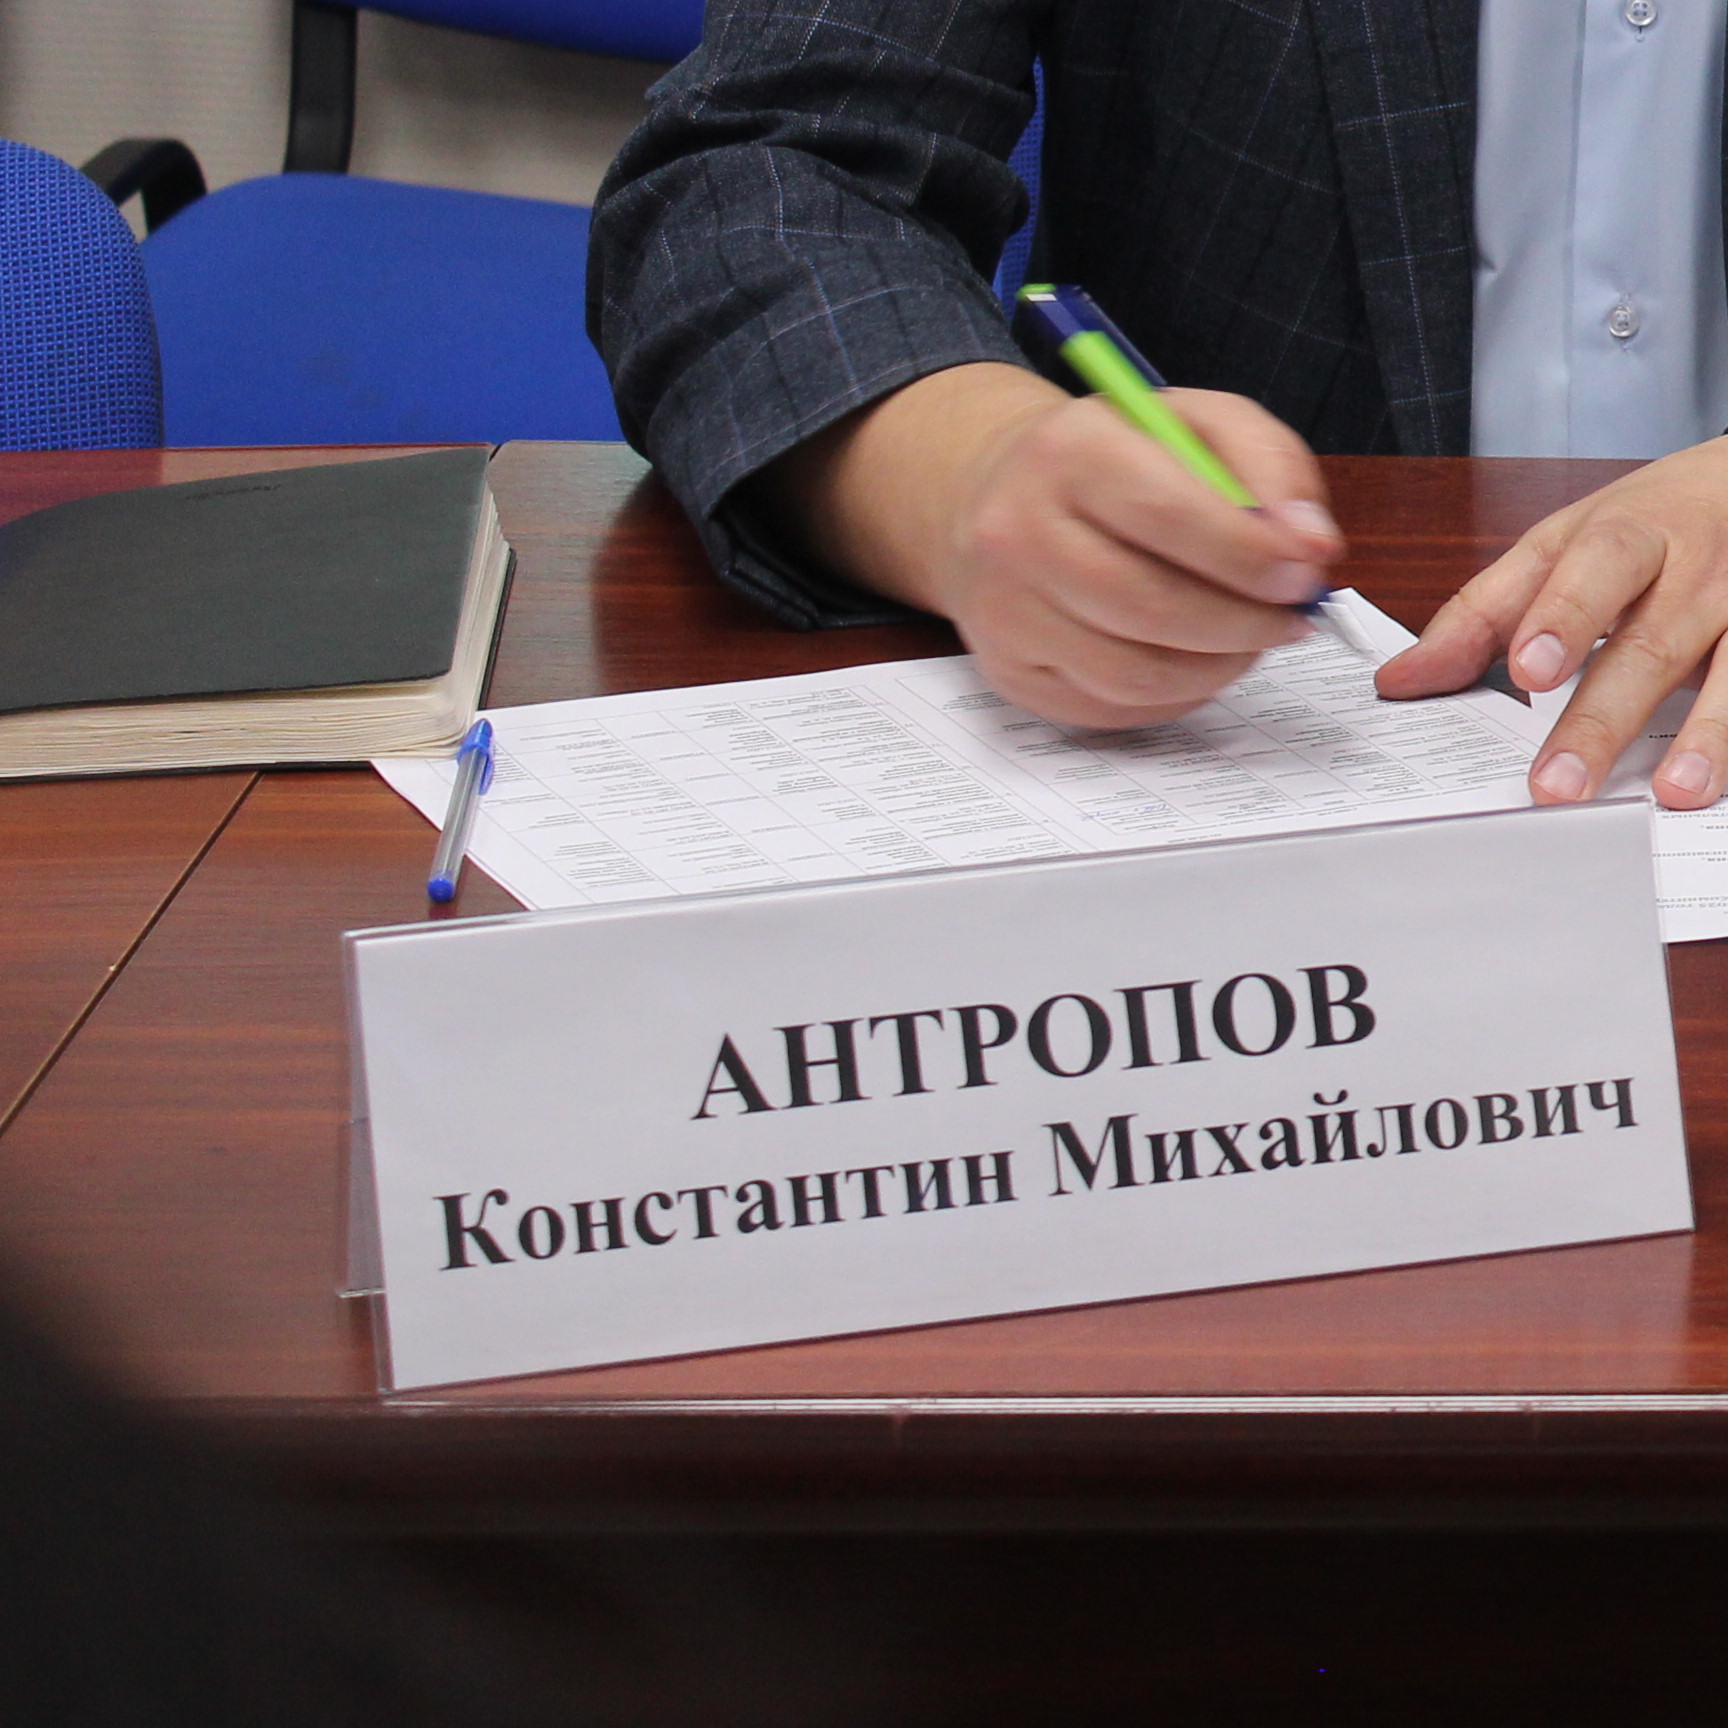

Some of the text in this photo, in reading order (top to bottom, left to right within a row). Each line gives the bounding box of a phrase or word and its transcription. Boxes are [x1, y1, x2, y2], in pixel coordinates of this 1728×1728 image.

[690, 963, 1377, 1120] АНТРОПОВ
[432, 1076, 1639, 1271] Константин Михайлович
